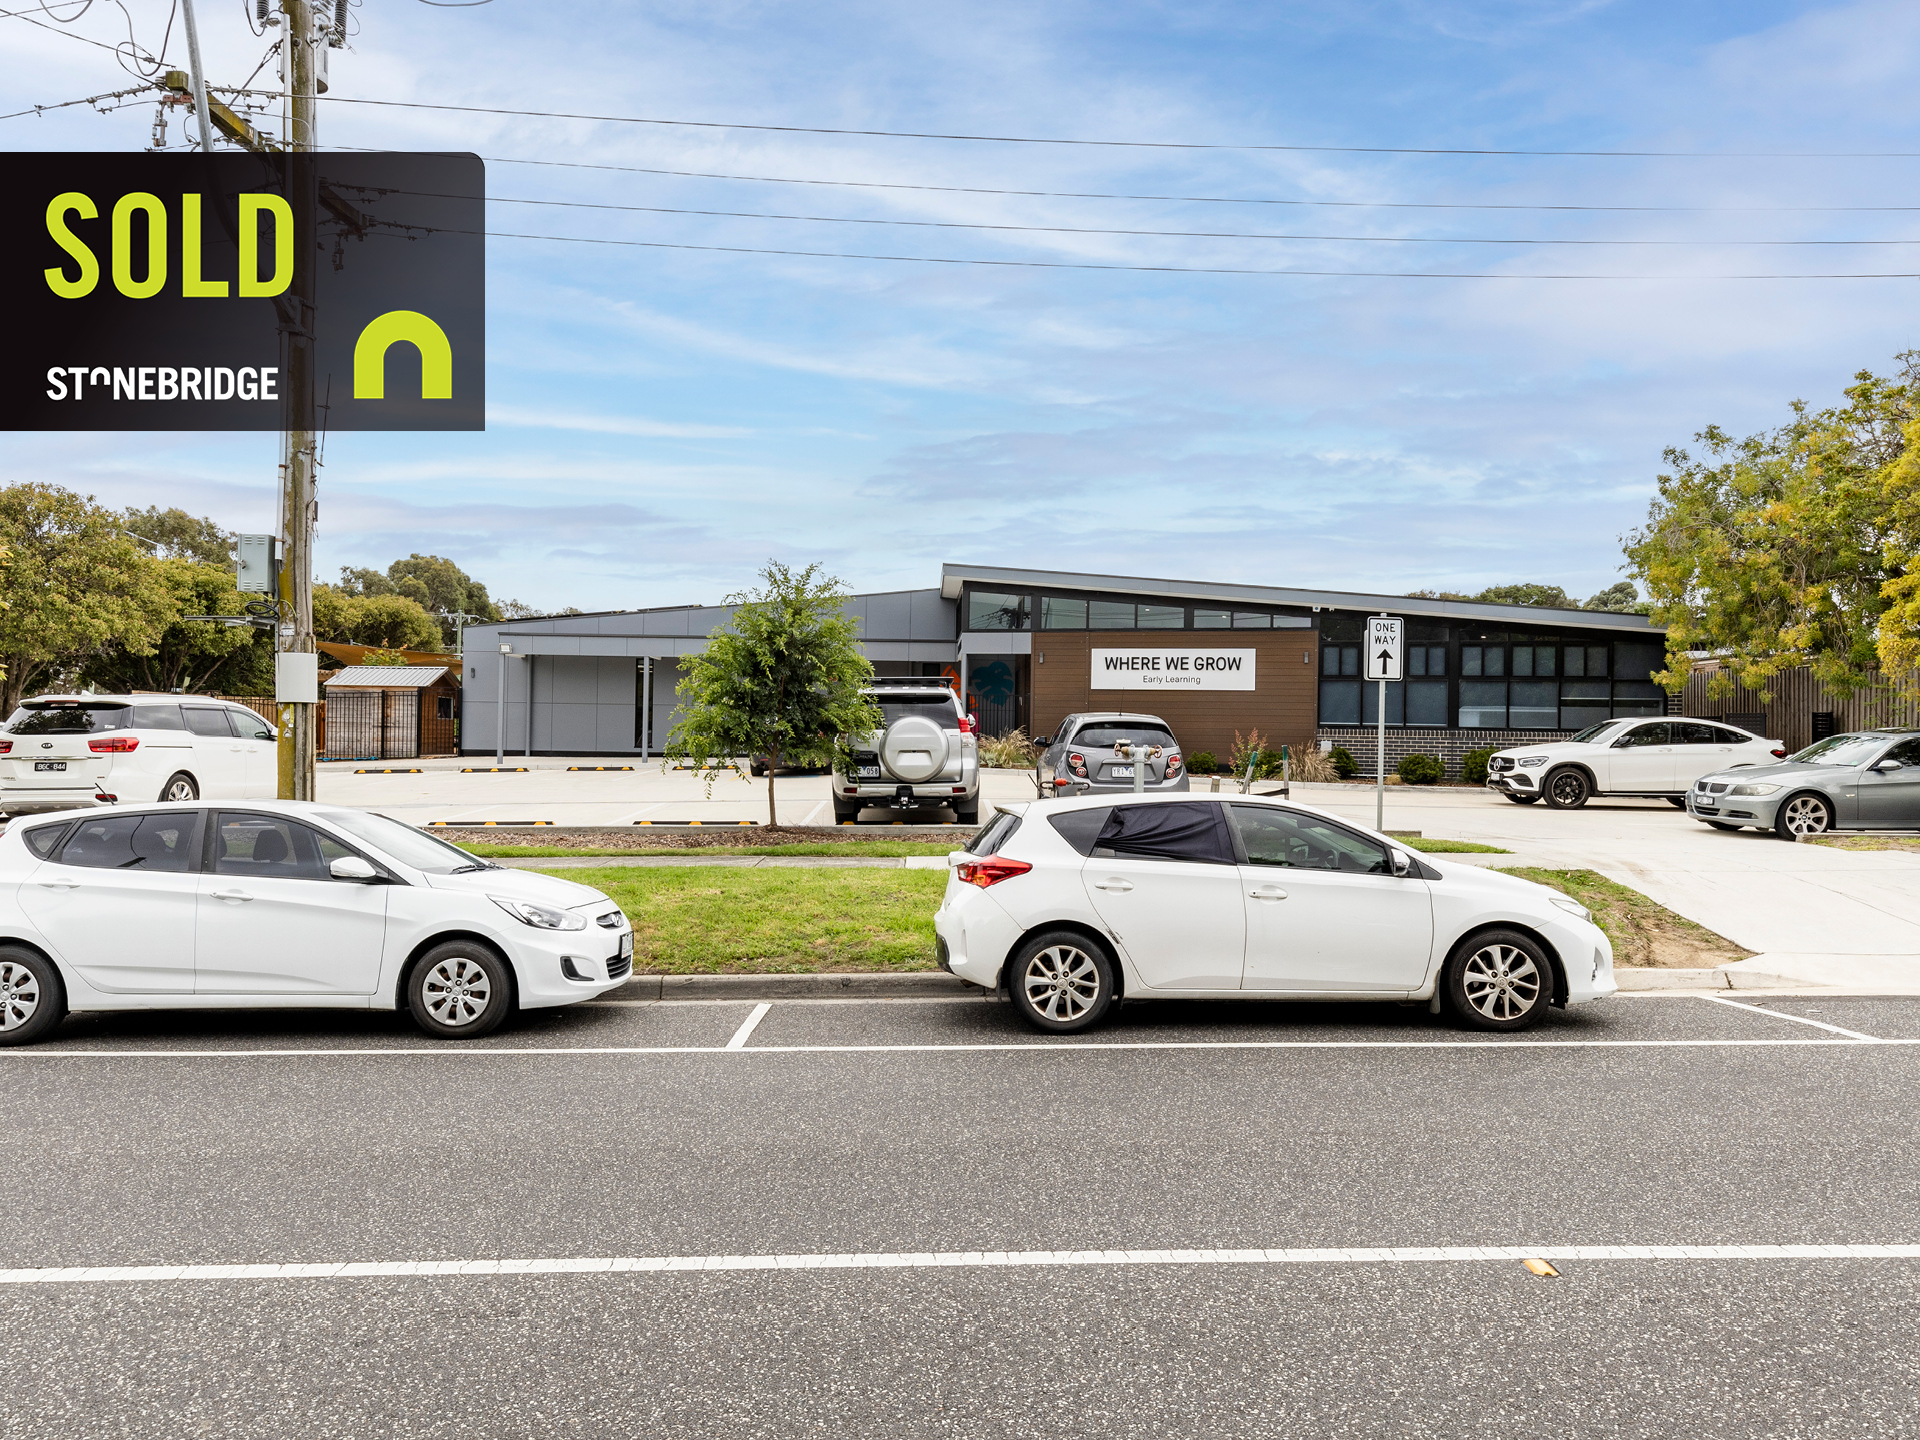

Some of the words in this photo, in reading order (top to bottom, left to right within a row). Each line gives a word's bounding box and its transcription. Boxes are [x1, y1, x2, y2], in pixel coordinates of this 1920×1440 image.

[1375, 622, 1396, 633] ONE
[1374, 635, 1397, 645] WAY
[1104, 656, 1161, 671] WHERE
[1165, 656, 1190, 671] WE
[1194, 656, 1242, 671] GROW
[1142, 675, 1164, 684] Early
[1165, 675, 1201, 686] Learning
